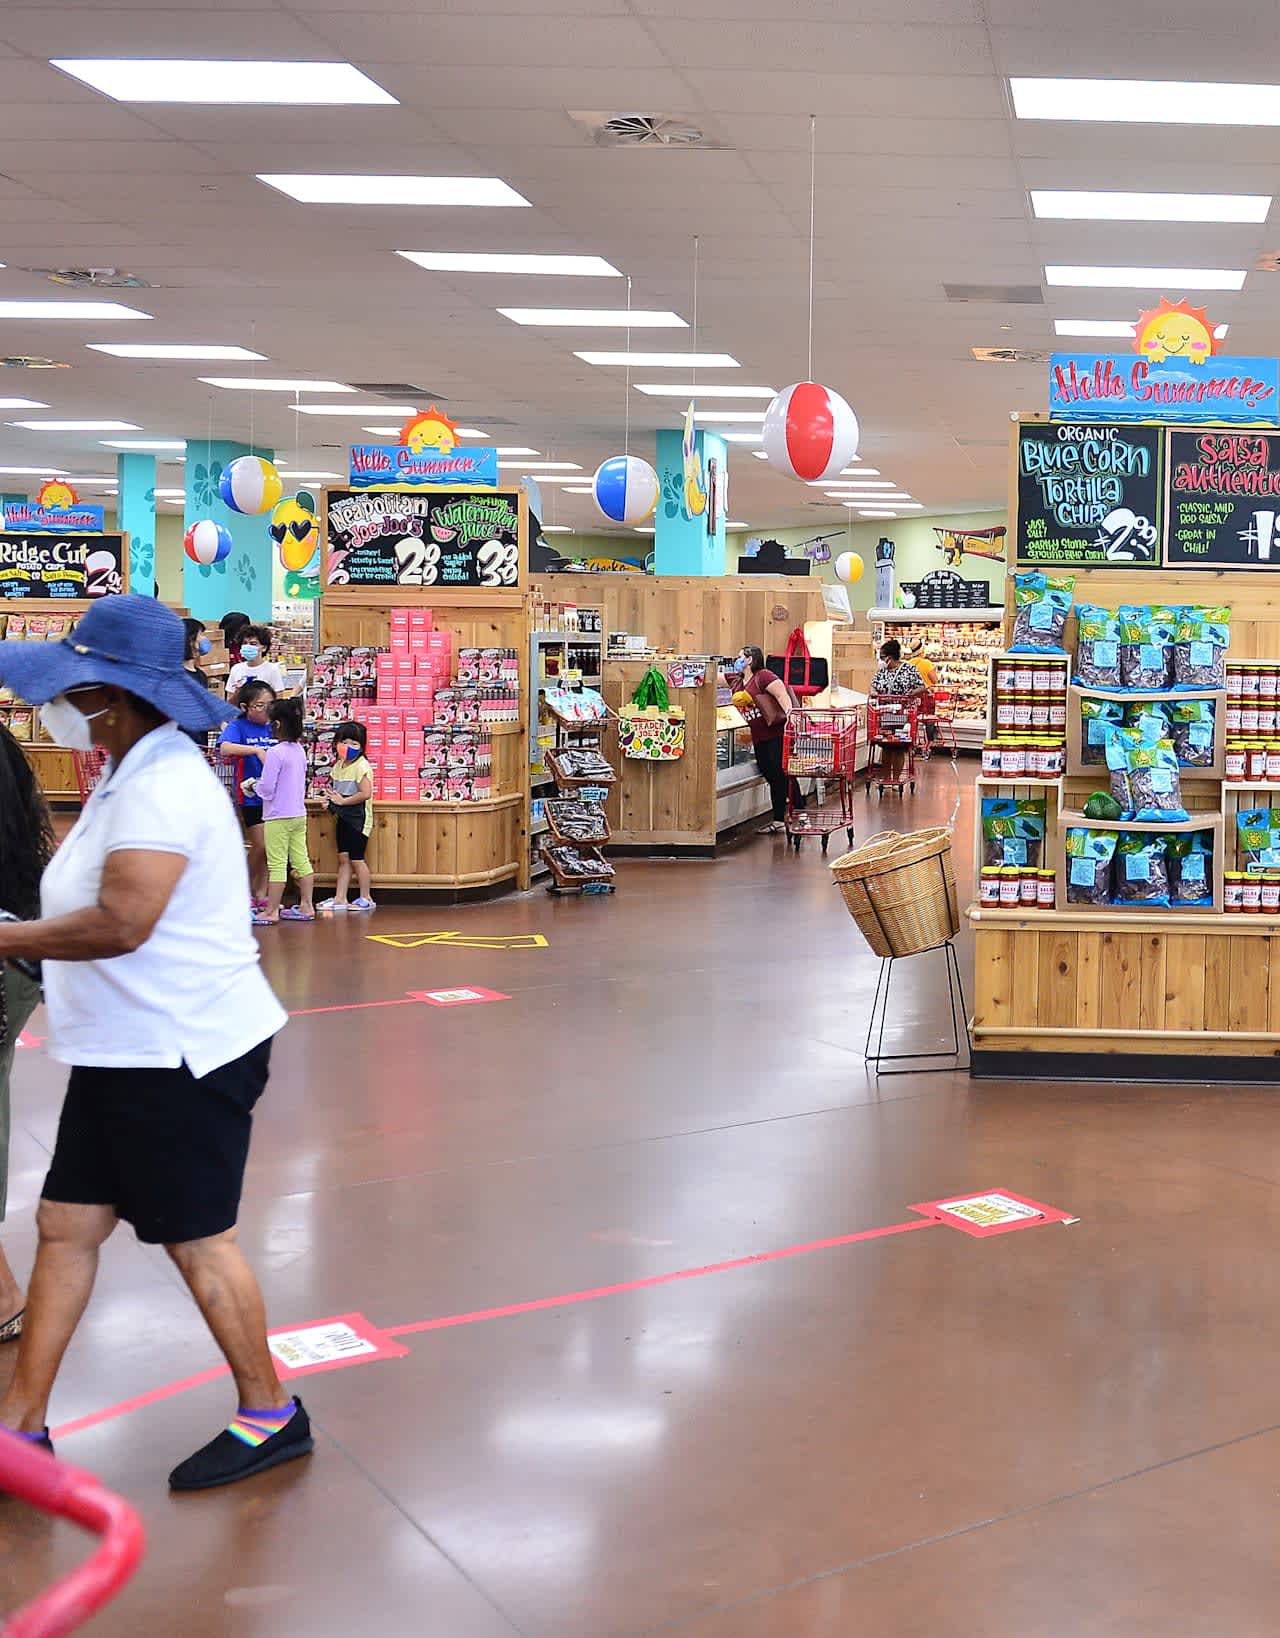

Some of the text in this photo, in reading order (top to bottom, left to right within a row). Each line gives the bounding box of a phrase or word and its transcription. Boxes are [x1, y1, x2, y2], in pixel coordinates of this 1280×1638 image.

[1057, 426, 1119, 441] ORGANIC
[329, 495, 428, 532] Neapolitan
[433, 501, 518, 531] Watermelon
[1058, 502, 1107, 524] CHIPS
[1214, 502, 1234, 513] MILD
[350, 515, 422, 546] Joe-Joe's
[1206, 529, 1216, 540] IN
[0, 540, 90, 565] Ridge Cut
[633, 722, 665, 731] TRADER
